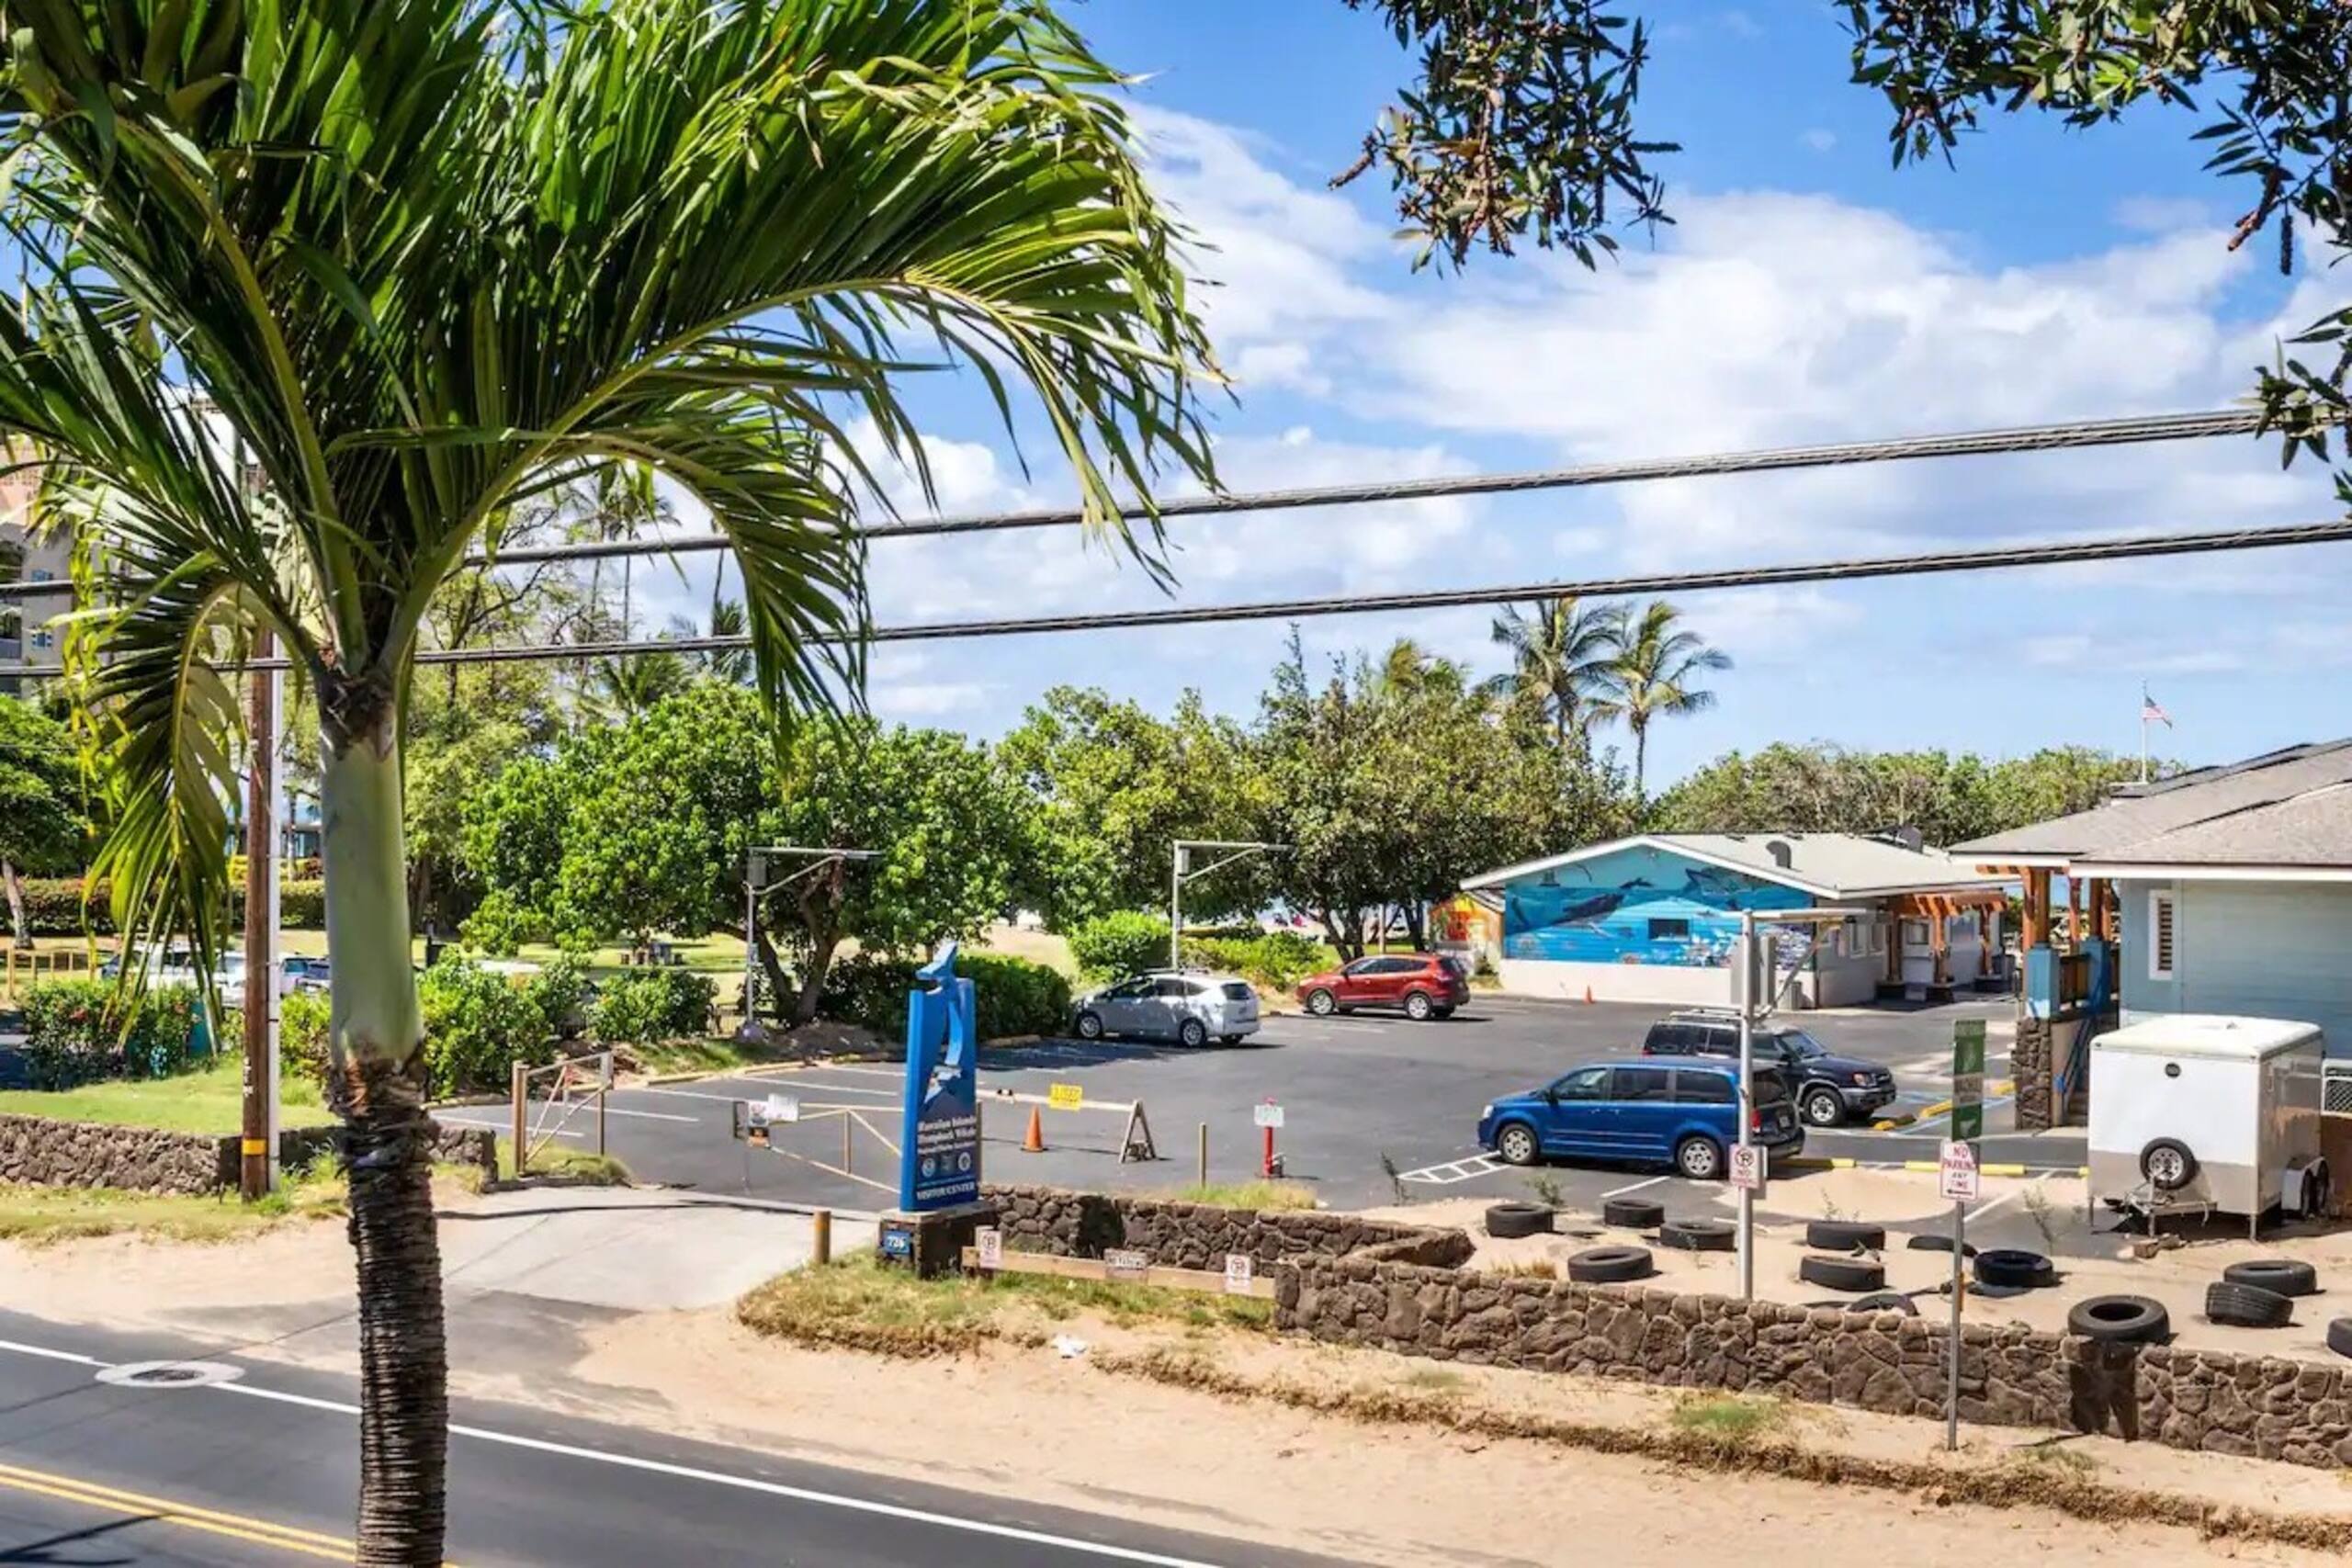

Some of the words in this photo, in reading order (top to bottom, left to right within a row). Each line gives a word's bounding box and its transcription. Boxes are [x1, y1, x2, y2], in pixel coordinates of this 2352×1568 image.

[1953, 1145, 1969, 1158] NO
[917, 1187, 945, 1201] VISITOR
[945, 1181, 976, 1195] CENTER
[1951, 1179, 1969, 1190] TIME
